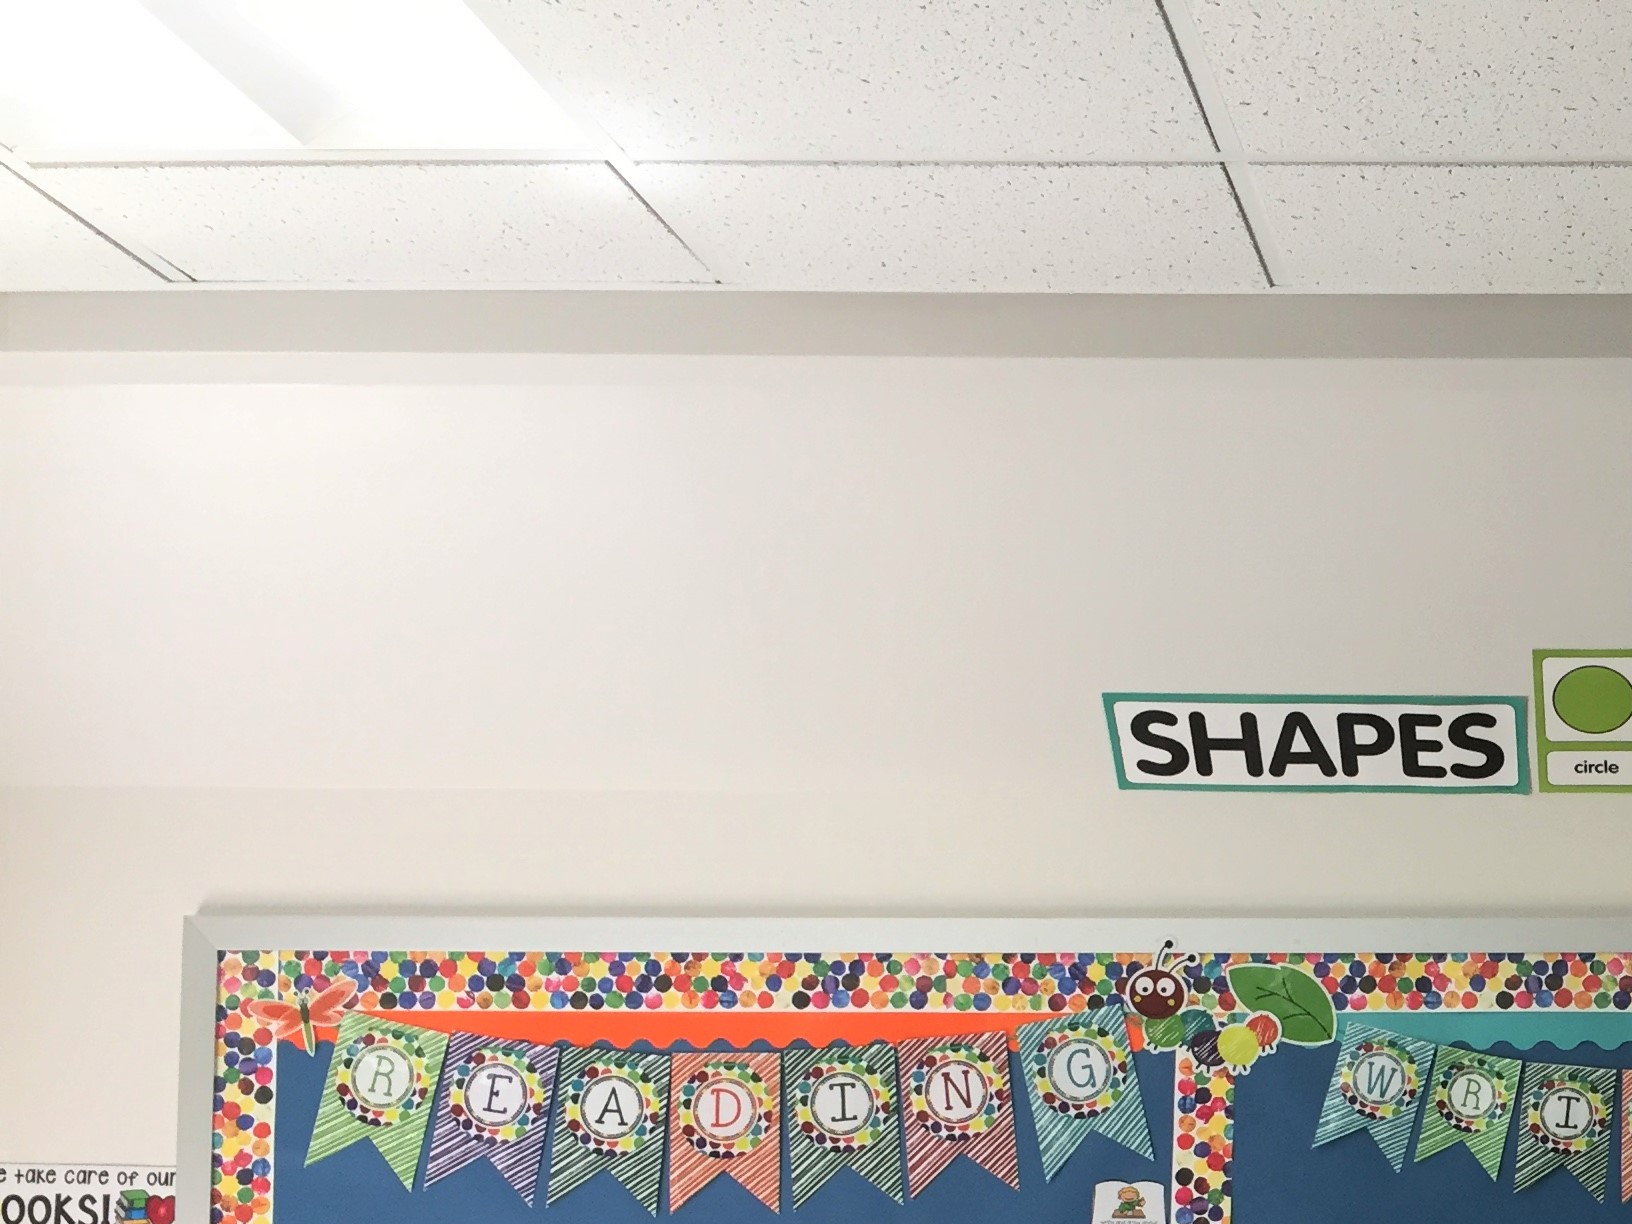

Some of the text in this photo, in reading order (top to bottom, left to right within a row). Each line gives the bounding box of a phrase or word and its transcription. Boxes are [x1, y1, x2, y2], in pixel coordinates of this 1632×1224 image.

[1130, 711, 1505, 779] SHAPES
[1573, 757, 1620, 776] circle
[367, 1048, 1097, 1128] READING
[14, 1167, 57, 1184] take
[64, 1168, 110, 1186] care
[116, 1169, 139, 1187] of
[146, 1171, 177, 1187] our
